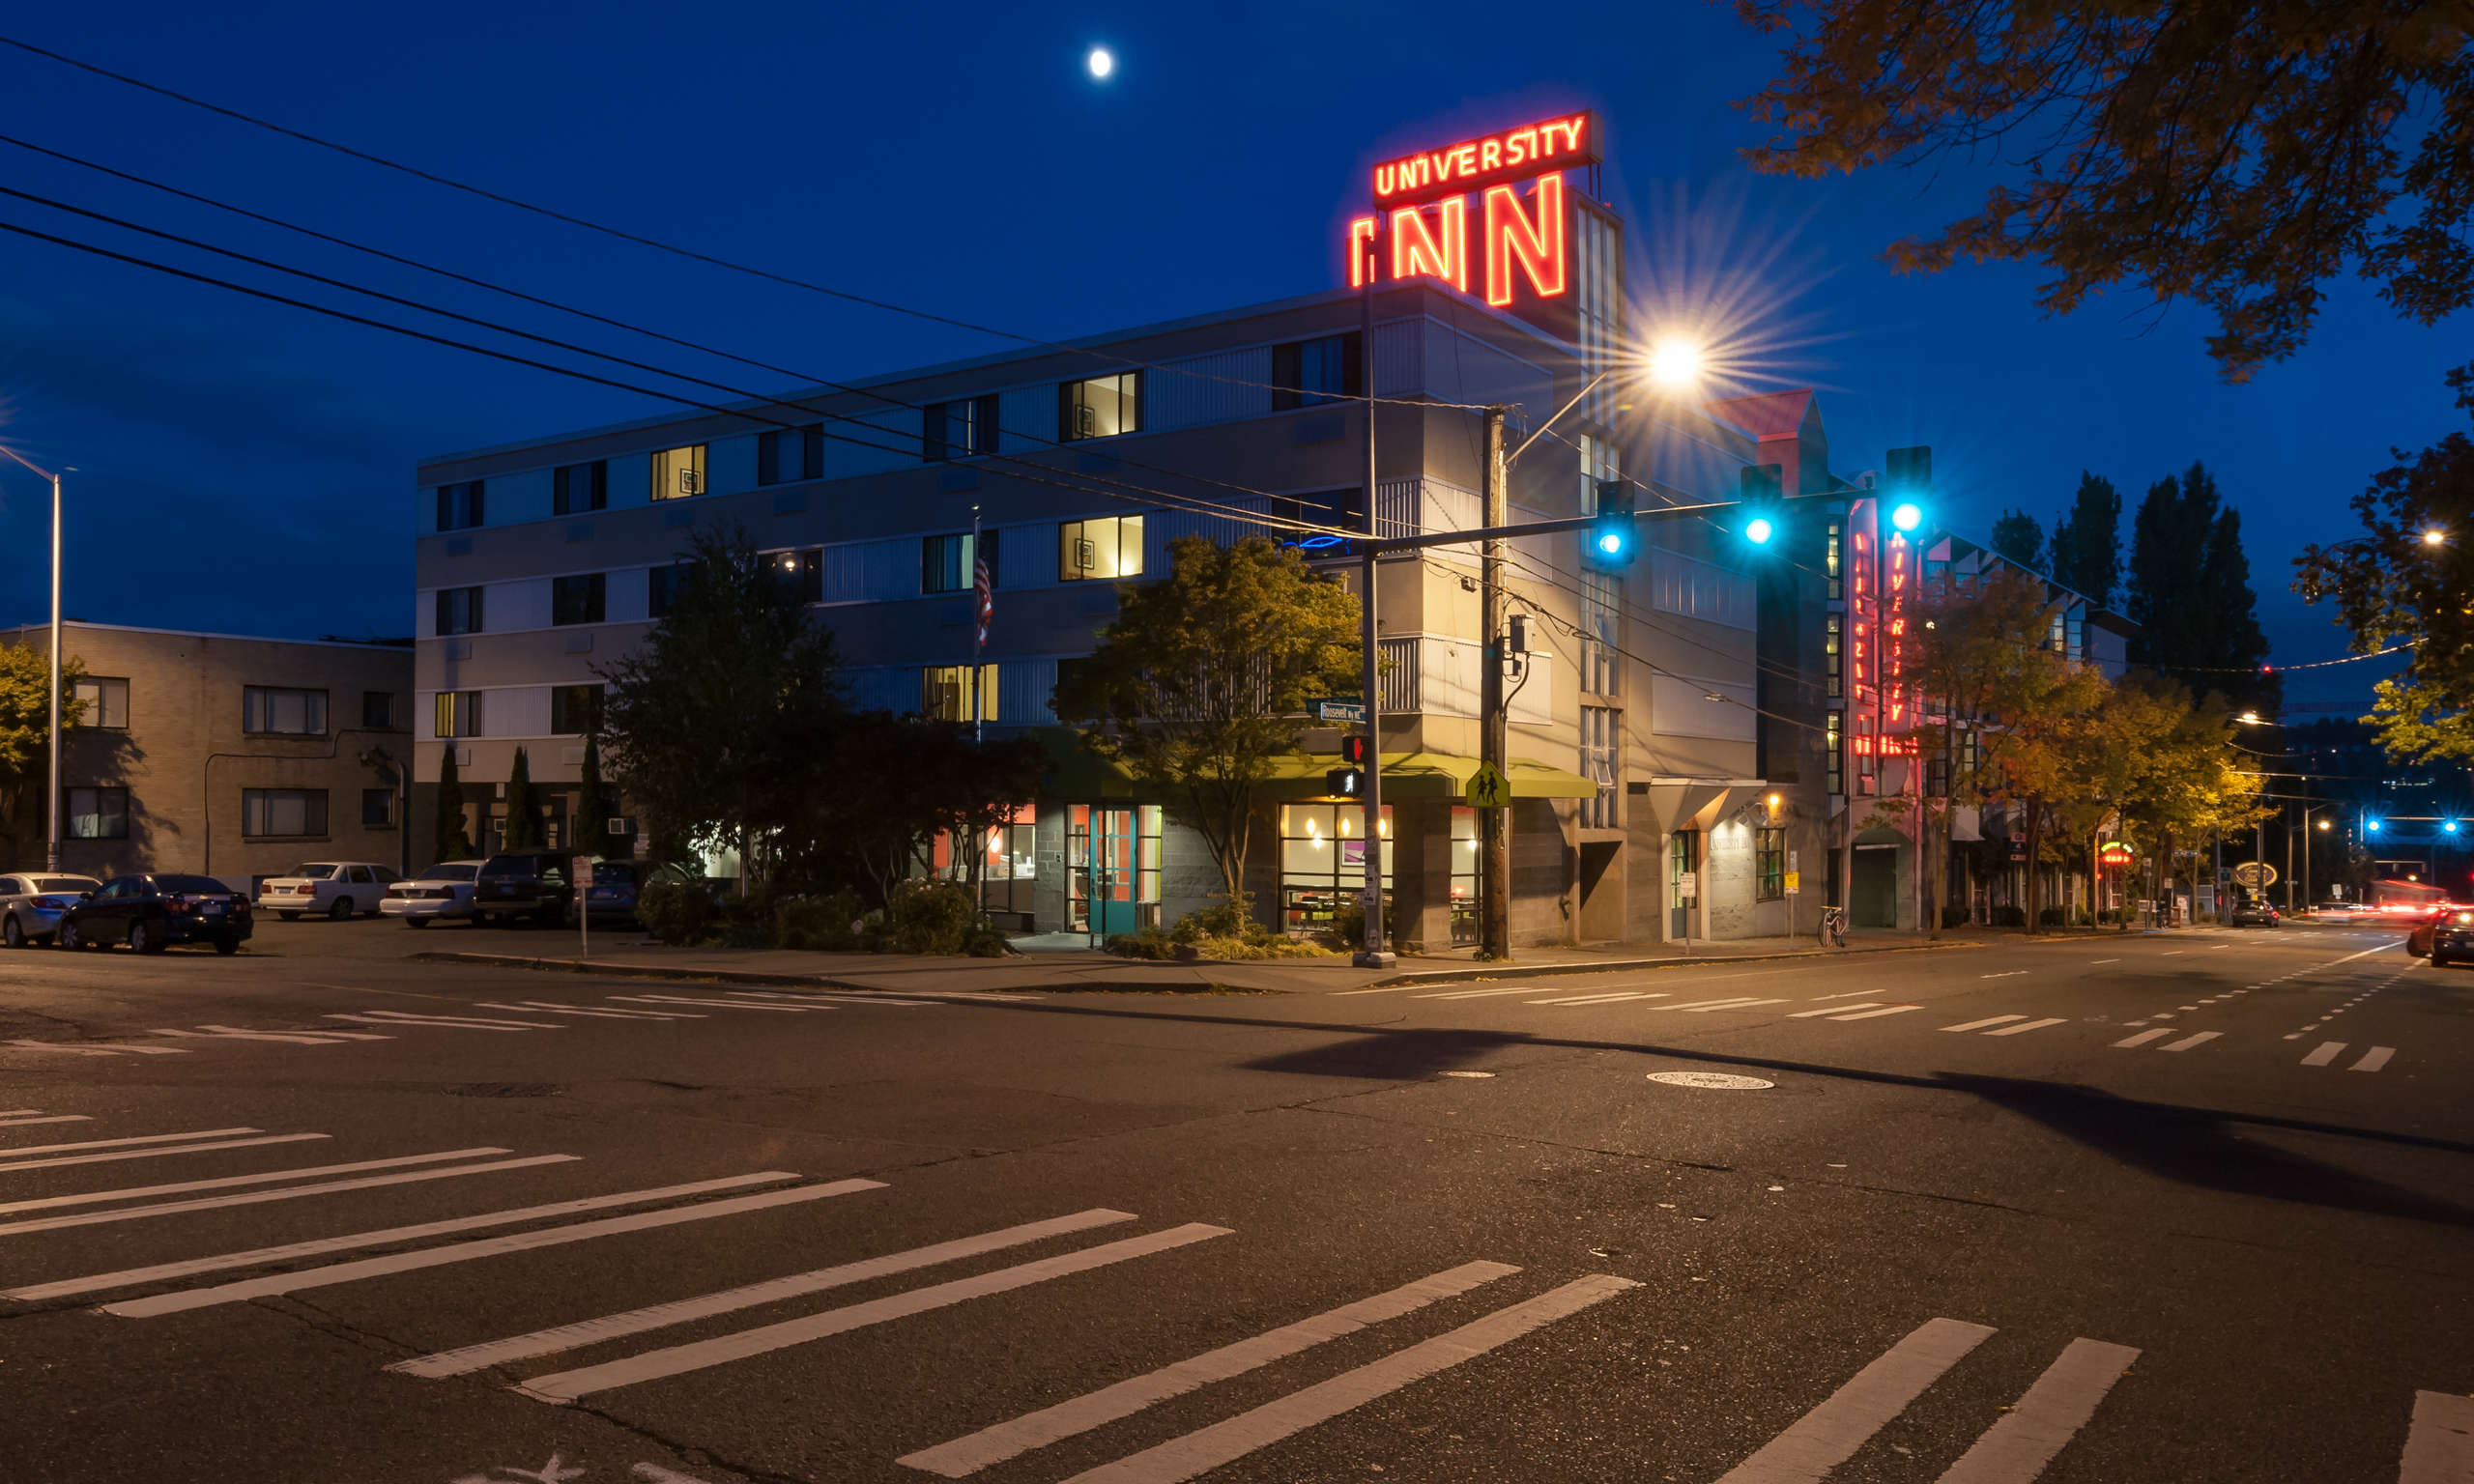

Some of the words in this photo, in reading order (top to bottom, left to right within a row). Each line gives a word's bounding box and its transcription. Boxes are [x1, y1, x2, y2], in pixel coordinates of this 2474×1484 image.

[1375, 117, 1585, 195] UNIVERSITY
[1353, 172, 1565, 305] INN
[1323, 704, 1347, 719] Roosevelt
